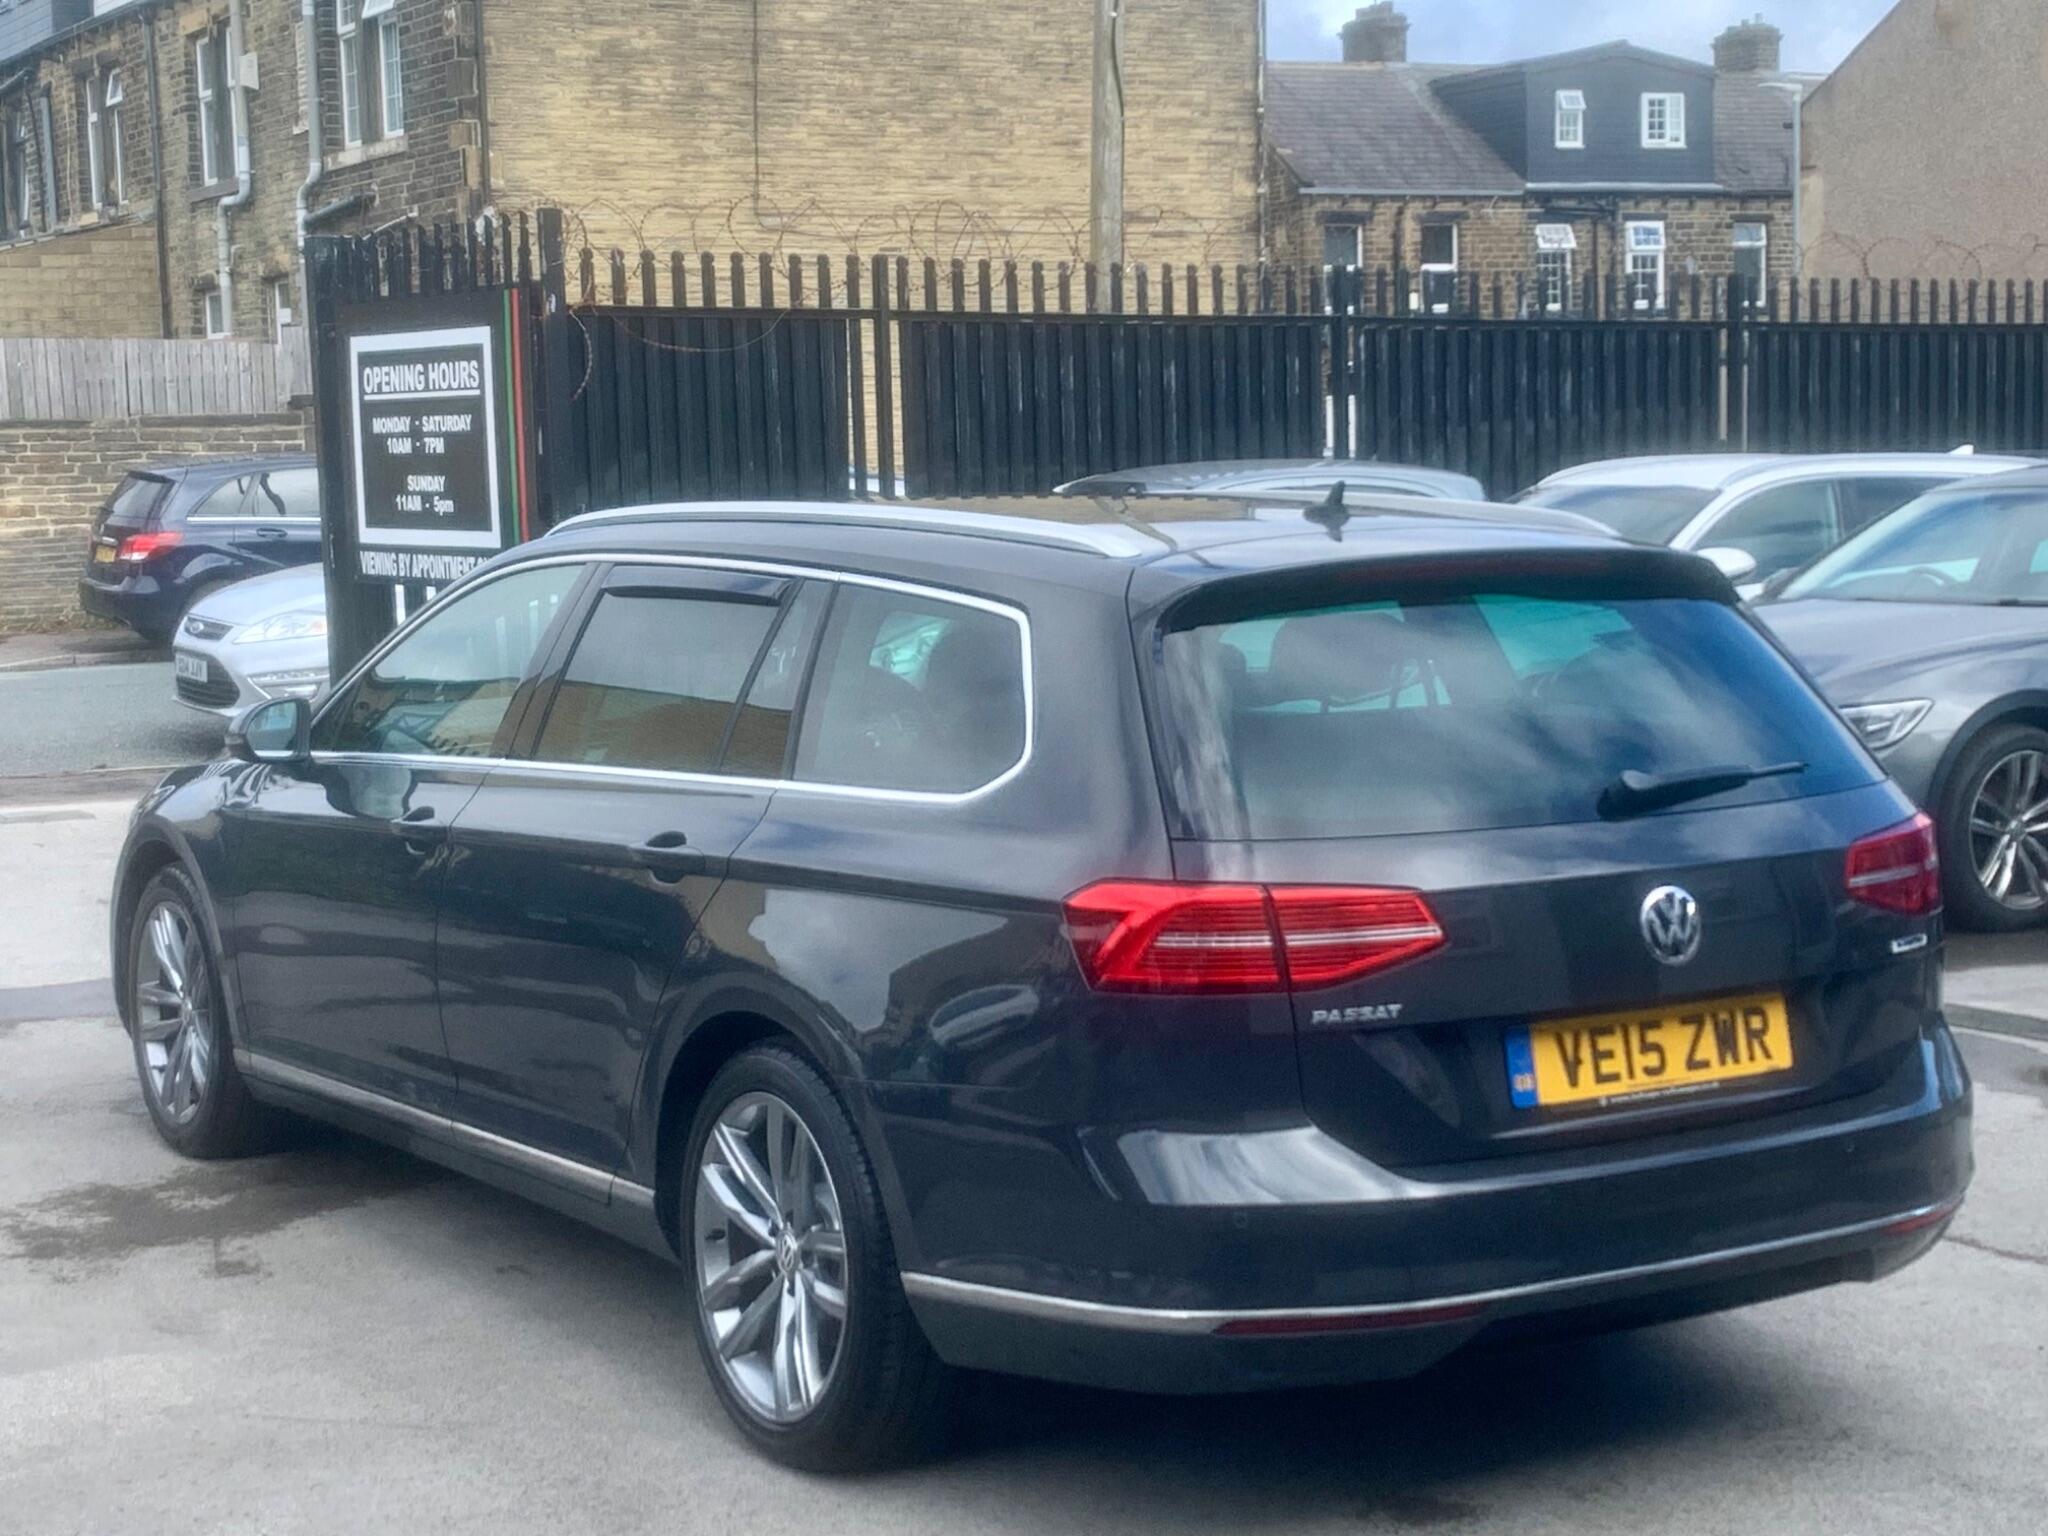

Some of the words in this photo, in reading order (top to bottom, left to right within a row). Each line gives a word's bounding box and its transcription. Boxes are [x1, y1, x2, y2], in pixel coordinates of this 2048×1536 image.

[363, 364, 425, 393] OPENING
[428, 360, 480, 390] HOURS
[372, 416, 411, 434] MONDAY
[422, 414, 472, 432] SATURDAY
[387, 437, 412, 454] 10AM
[424, 437, 445, 454] 7PM
[407, 475, 445, 492] SUNDAY
[396, 494, 422, 511] 11AM
[433, 495, 454, 516] 5pm
[360, 550, 397, 576] VIEWING
[398, 553, 411, 577] BY
[1311, 1003, 1402, 1024] PASSAT
[1555, 1020, 1667, 1088] VE15
[1682, 1005, 1773, 1072] ZWR
